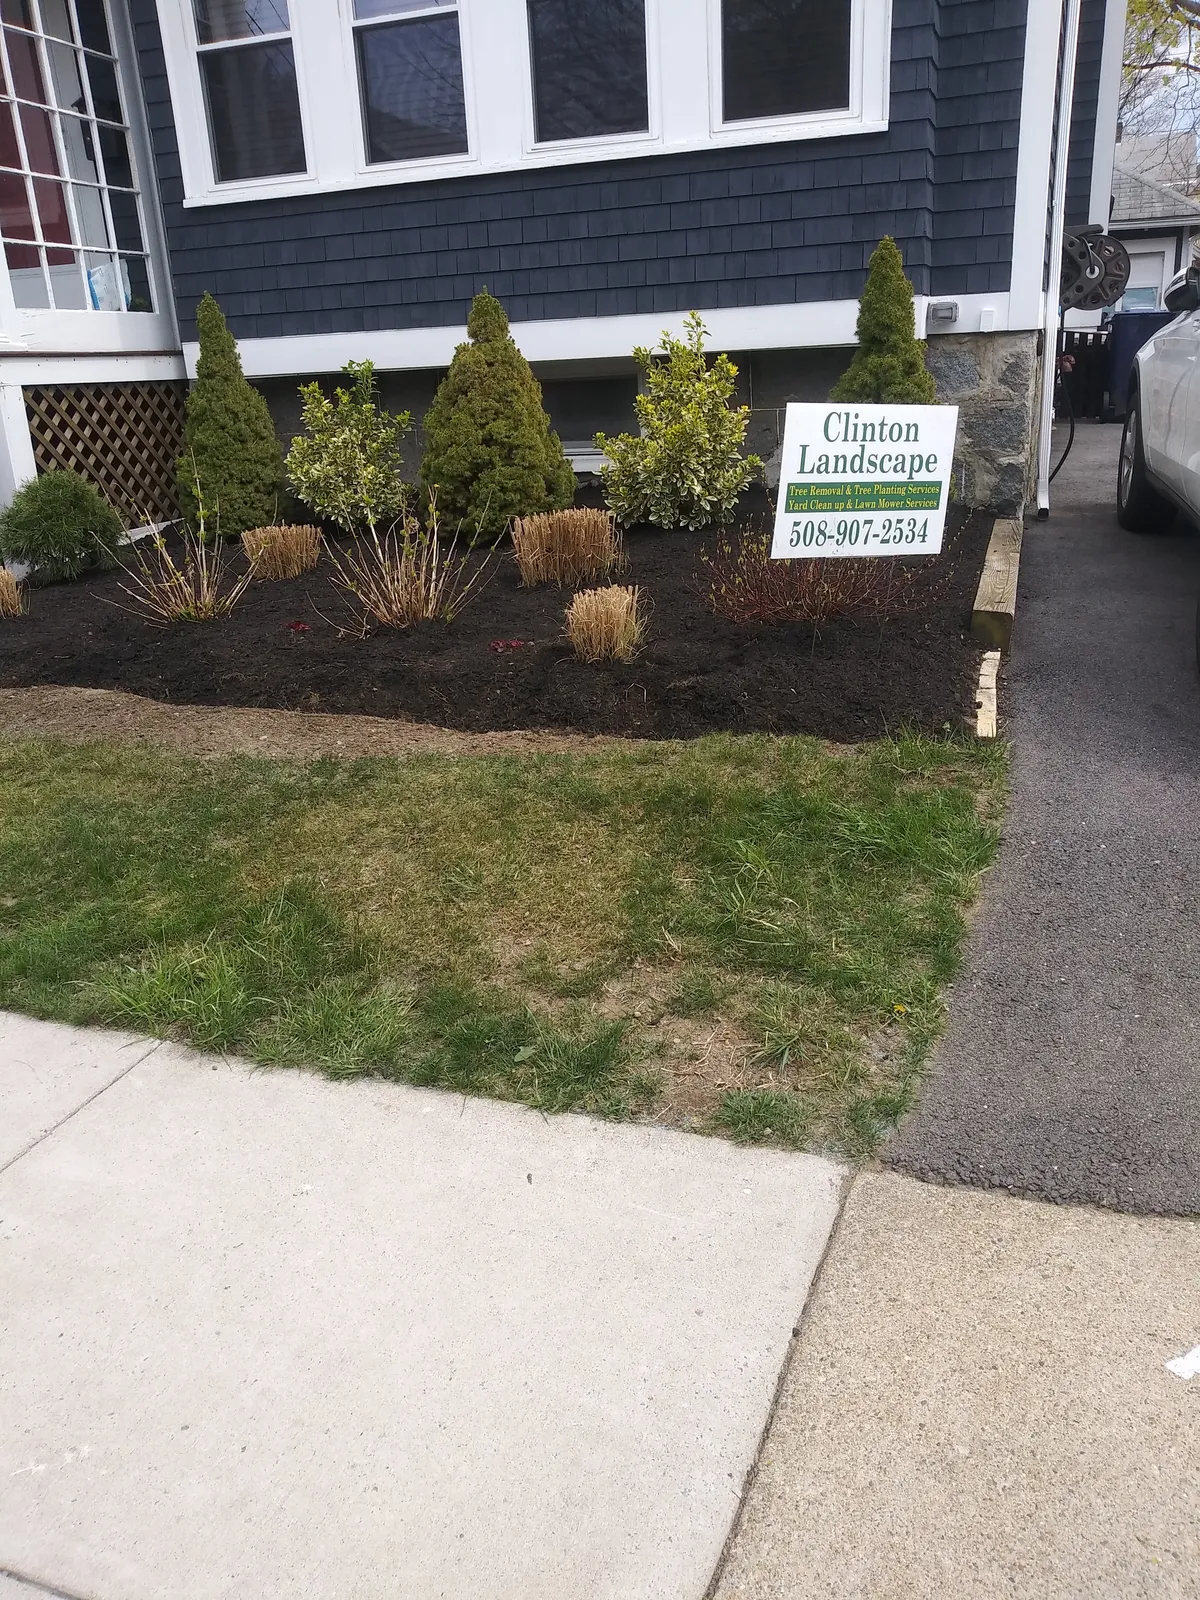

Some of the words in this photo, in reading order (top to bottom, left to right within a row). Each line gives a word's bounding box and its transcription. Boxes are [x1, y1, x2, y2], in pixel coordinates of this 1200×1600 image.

[823, 411, 919, 443] Clinton
[796, 444, 938, 480] Landscape
[788, 500, 808, 510] Yard
[810, 499, 833, 510] Clean
[834, 501, 845, 511] up
[846, 499, 852, 509] &
[855, 499, 876, 509] Lawn
[878, 498, 904, 508] Mower
[905, 497, 937, 508] Services
[789, 485, 808, 496] Tree
[809, 485, 844, 496] Removal
[845, 485, 852, 495] &
[854, 484, 872, 495] Tree
[873, 484, 906, 496] Planting
[907, 483, 939, 494] Services
[789, 517, 929, 548] 508-907-2534
